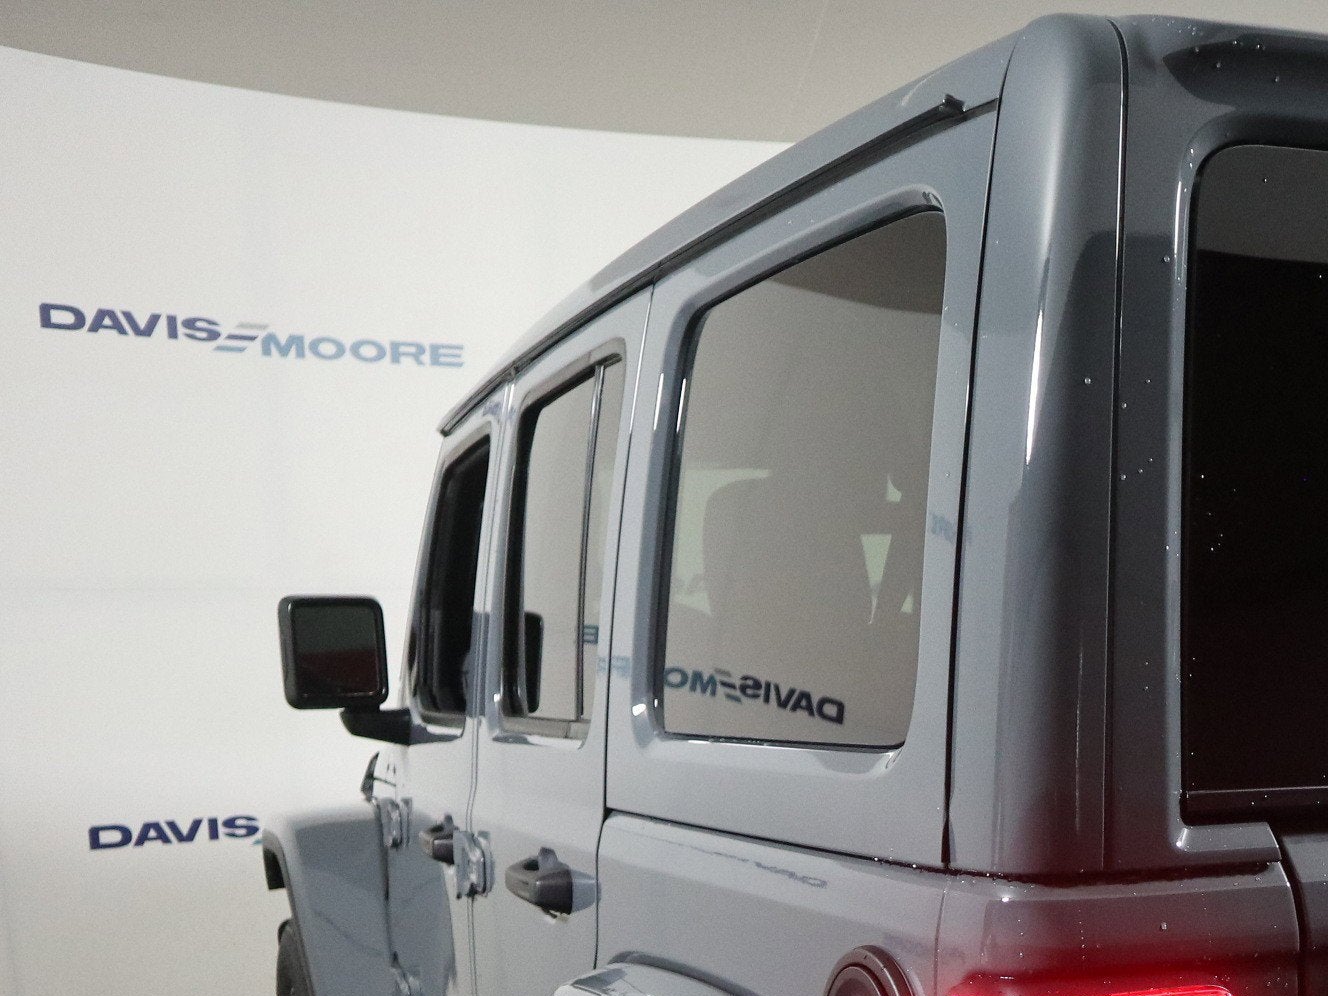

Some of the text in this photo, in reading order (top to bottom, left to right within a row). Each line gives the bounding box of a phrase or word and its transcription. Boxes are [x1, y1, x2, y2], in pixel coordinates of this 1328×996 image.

[38, 302, 465, 368] DAVIS MOORE
[88, 815, 260, 851] DAVIS
